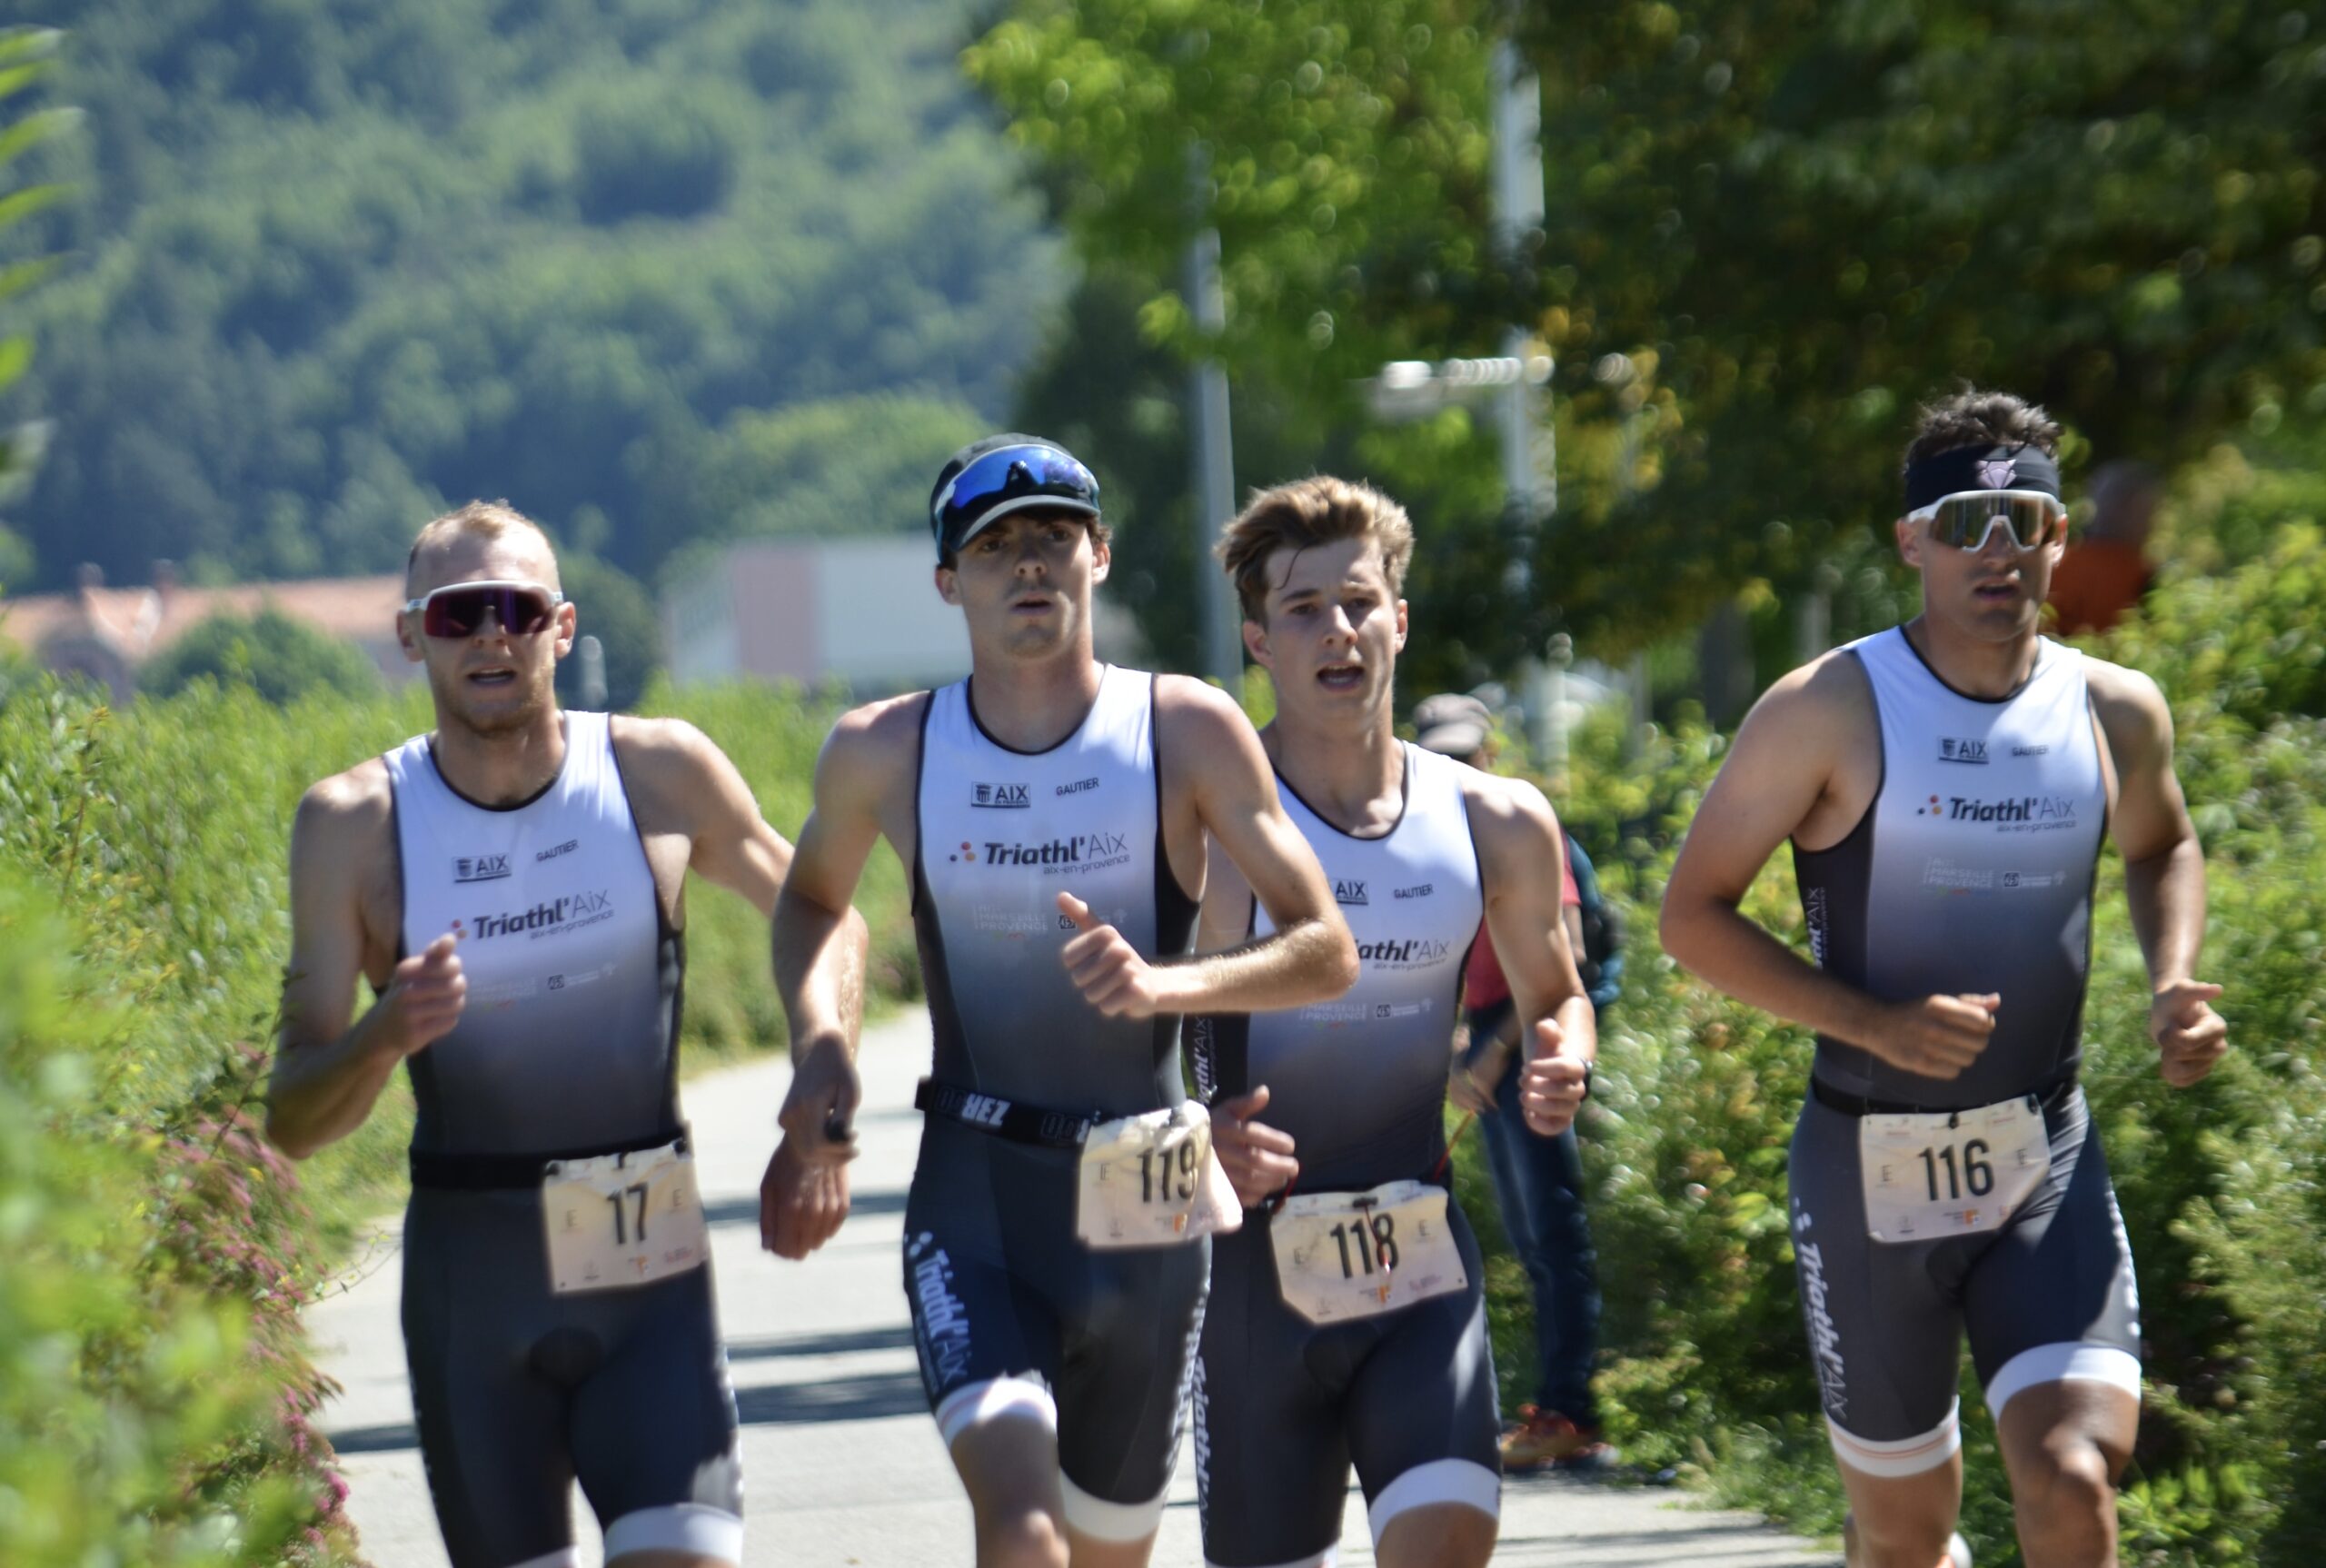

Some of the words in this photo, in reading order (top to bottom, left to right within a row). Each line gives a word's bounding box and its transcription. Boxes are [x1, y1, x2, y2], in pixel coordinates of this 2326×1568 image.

[1960, 741, 1987, 757] AIX
[2012, 745, 2049, 757] GAUTIER
[995, 786, 1028, 800] AIX
[1056, 777, 1099, 797] GAUTIER
[1997, 820, 2077, 833] aix-en-provence
[536, 839, 579, 862] GAUTIER
[985, 832, 1128, 865] Triathl'Aix
[477, 856, 508, 873] AIX
[1043, 853, 1130, 875] aix-en-provence
[1336, 880, 1366, 897] AIX
[1394, 884, 1433, 899] GAUTIER
[530, 909, 614, 939] aix-en-provence
[1138, 1137, 1198, 1204] 119
[1918, 1138, 1994, 1201] 116
[608, 1182, 649, 1245] 17
[672, 1188, 683, 1207] E
[1330, 1213, 1399, 1279] 118
